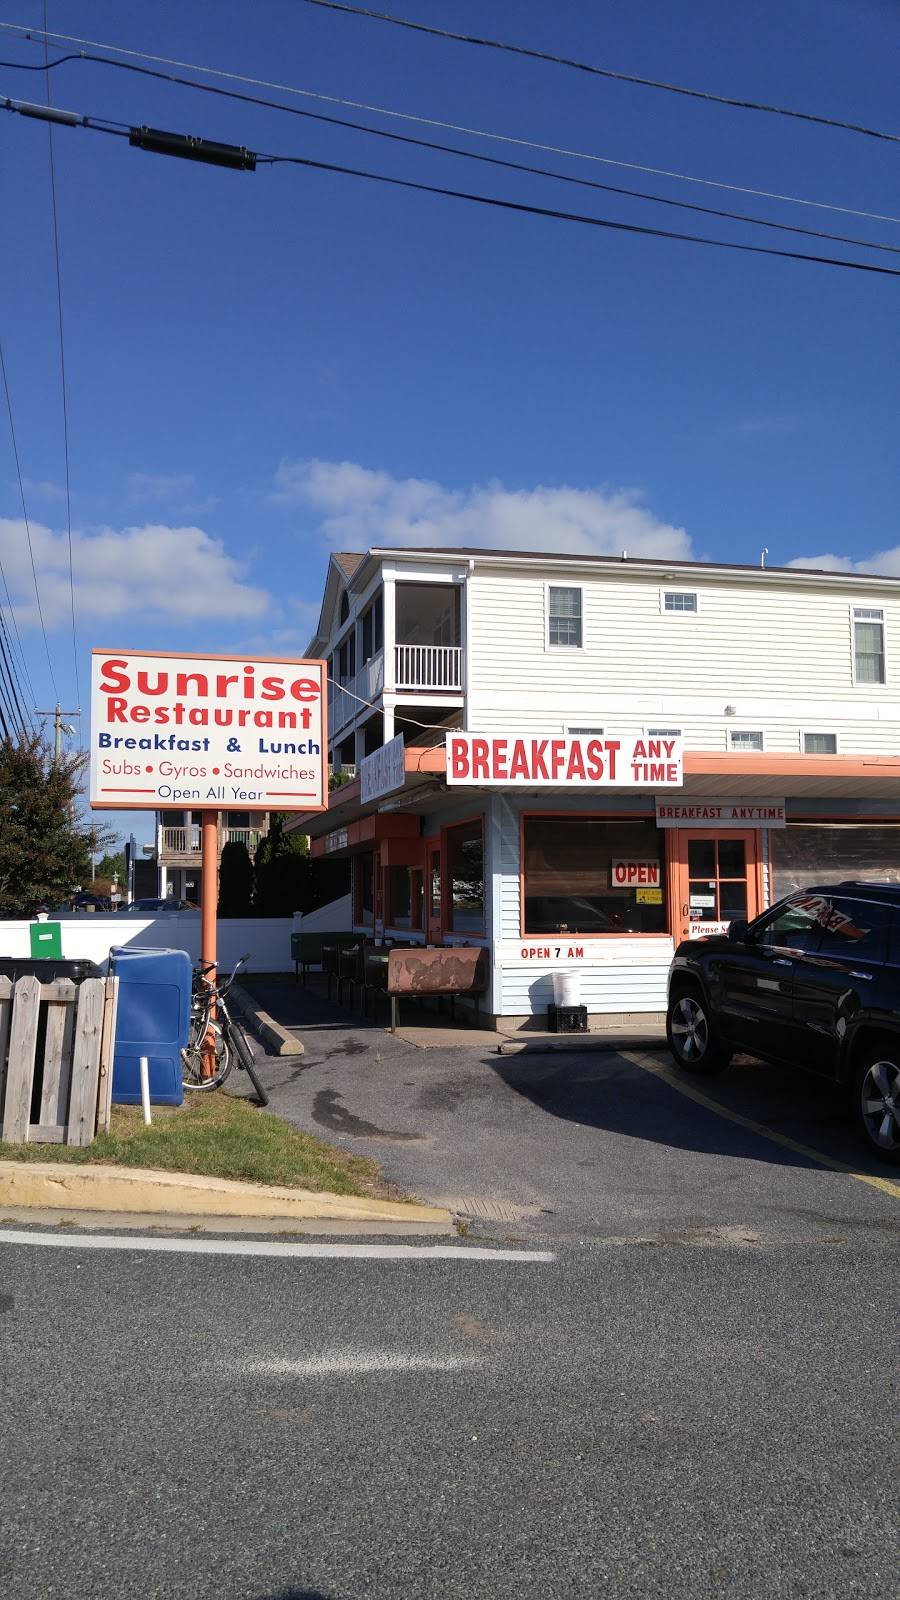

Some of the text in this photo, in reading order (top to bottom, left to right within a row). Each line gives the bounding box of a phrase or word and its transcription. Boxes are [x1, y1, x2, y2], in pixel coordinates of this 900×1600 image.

[99, 659, 320, 702] Sunrise
[107, 697, 312, 728] Restaurant
[98, 732, 320, 754] Breakfast & Lunch
[102, 759, 315, 780] Subs Gyros Sandwiches
[451, 738, 675, 780] BREAKFAST ANY
[631, 763, 678, 781] TIME
[158, 785, 264, 800] Open All Year
[659, 807, 722, 818] BREAKFAST
[615, 862, 657, 883] OPEN
[691, 925, 719, 934] Please
[521, 947, 584, 959] OPEN 7 AM
